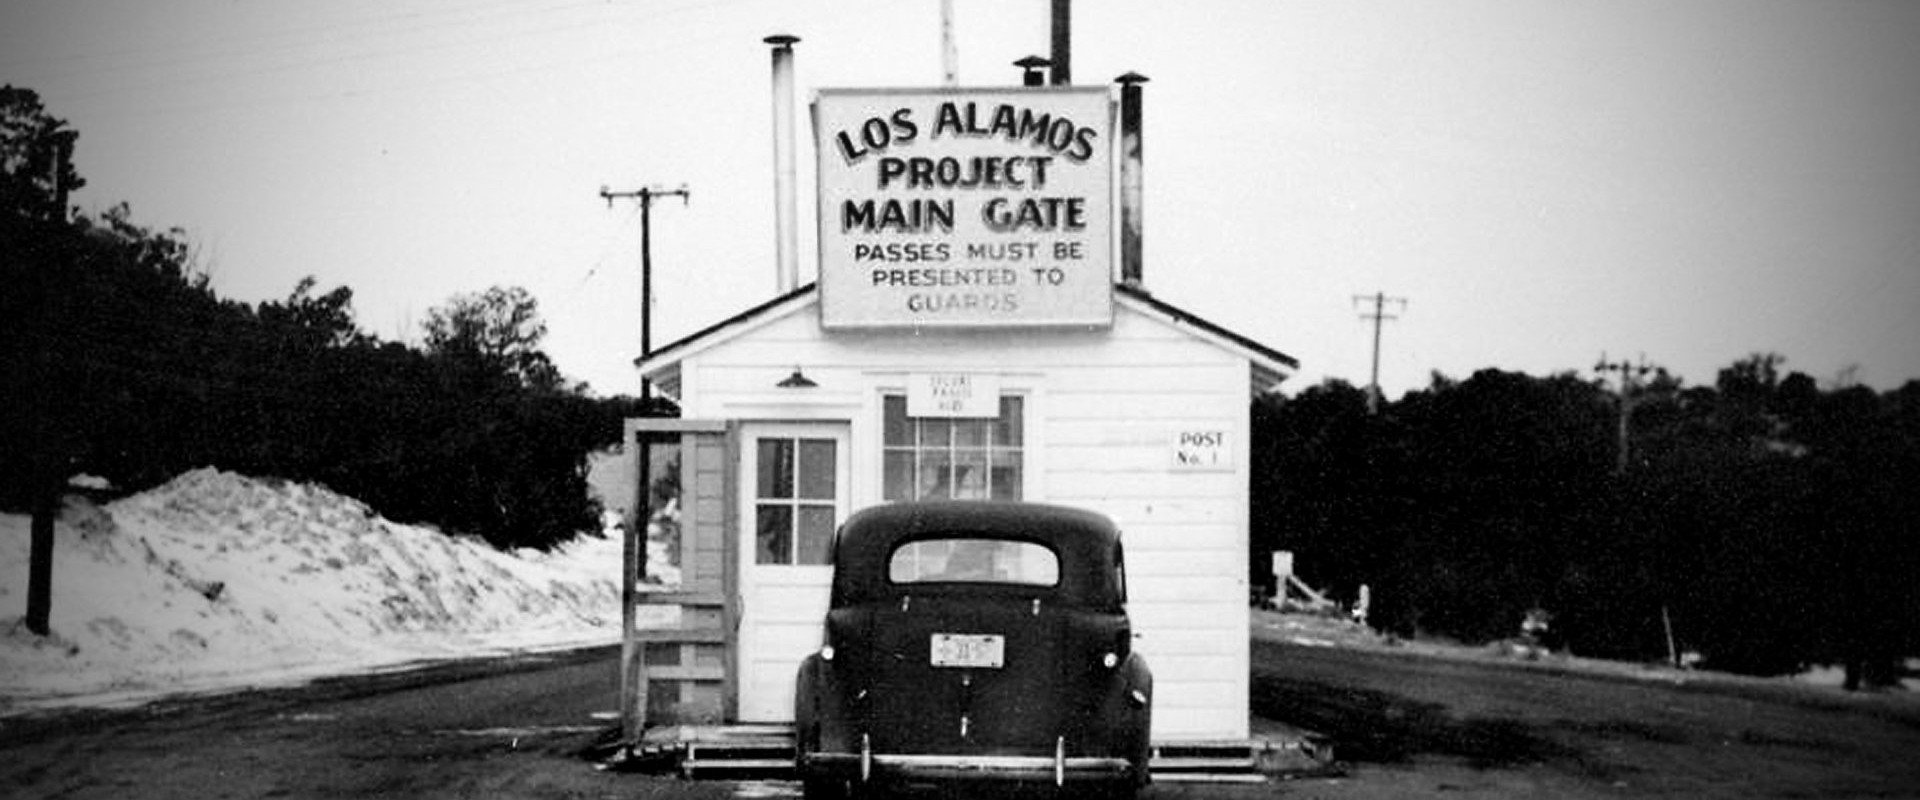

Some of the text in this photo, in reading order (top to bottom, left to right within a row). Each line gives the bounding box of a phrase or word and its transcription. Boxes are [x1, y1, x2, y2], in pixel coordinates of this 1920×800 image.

[836, 102, 1098, 167] LOS ALAMOS
[878, 156, 1053, 190] PROJECT
[841, 197, 1087, 234] MAIN GATE
[855, 242, 1085, 263] PASSES MUST BE
[872, 268, 1065, 287] PRESENTED TO
[1181, 432, 1222, 447] POST
